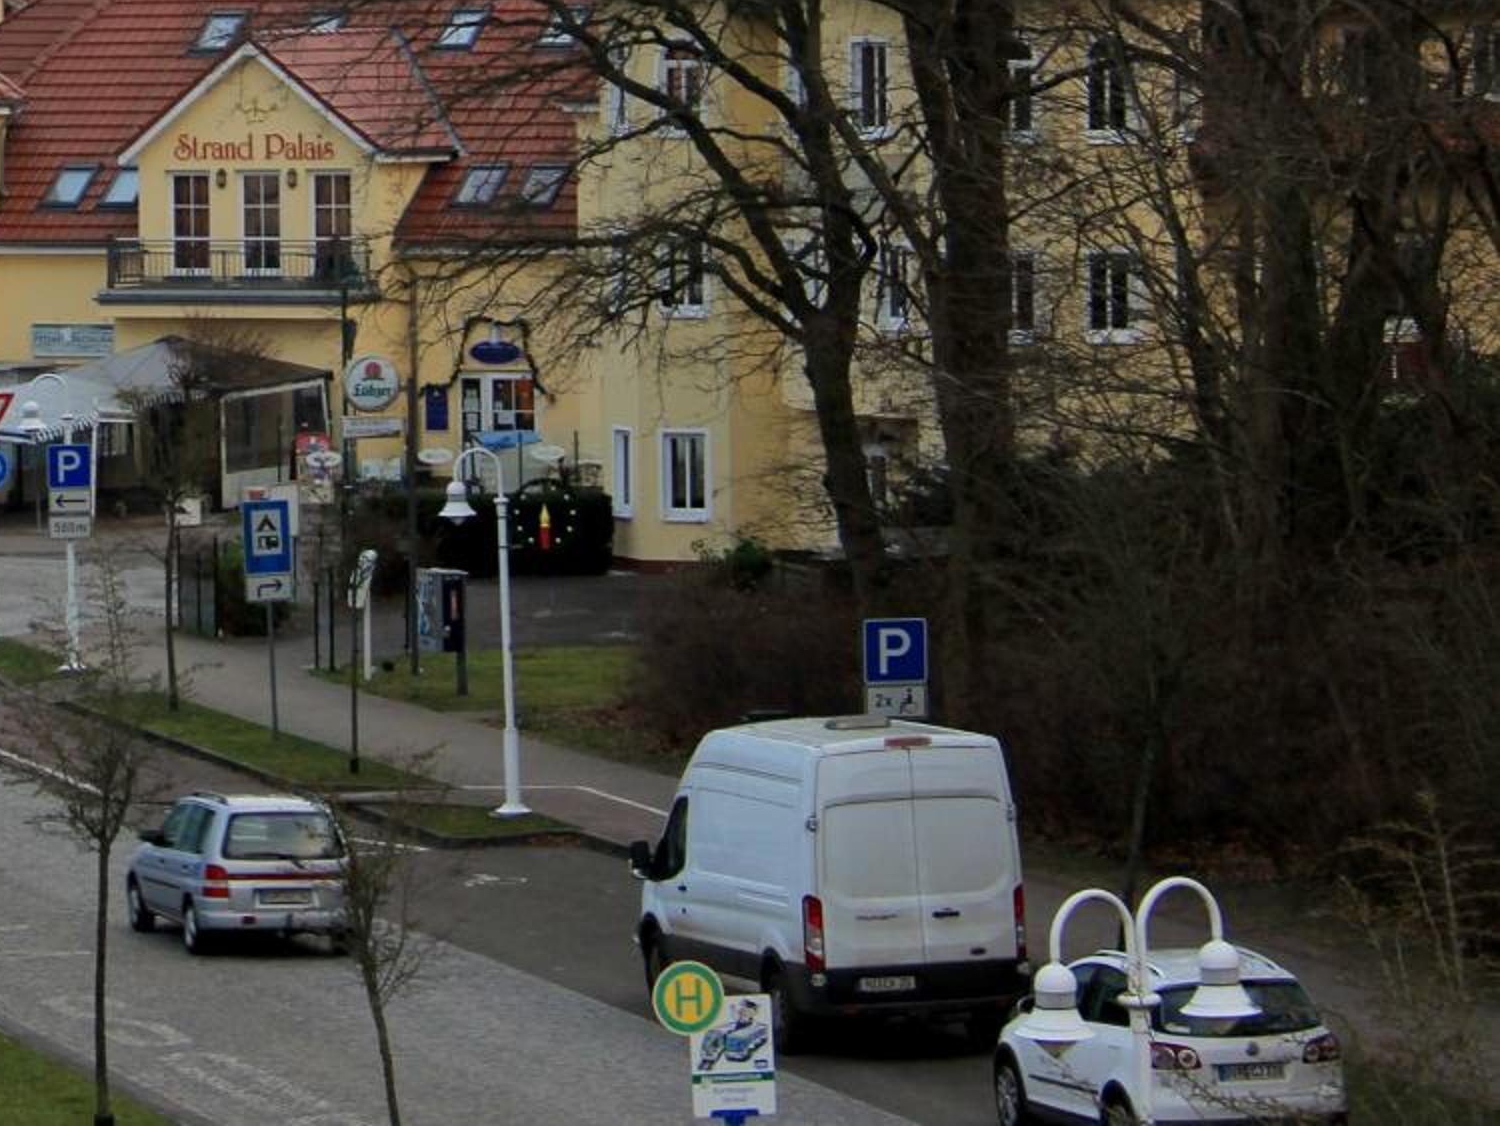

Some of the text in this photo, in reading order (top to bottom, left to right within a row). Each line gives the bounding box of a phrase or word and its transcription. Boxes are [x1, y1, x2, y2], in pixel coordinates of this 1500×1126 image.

[173, 133, 336, 161] Strand Palais
[57, 449, 81, 483] P
[878, 627, 911, 675] P
[875, 693, 892, 708] 2x
[675, 978, 703, 1018] H
